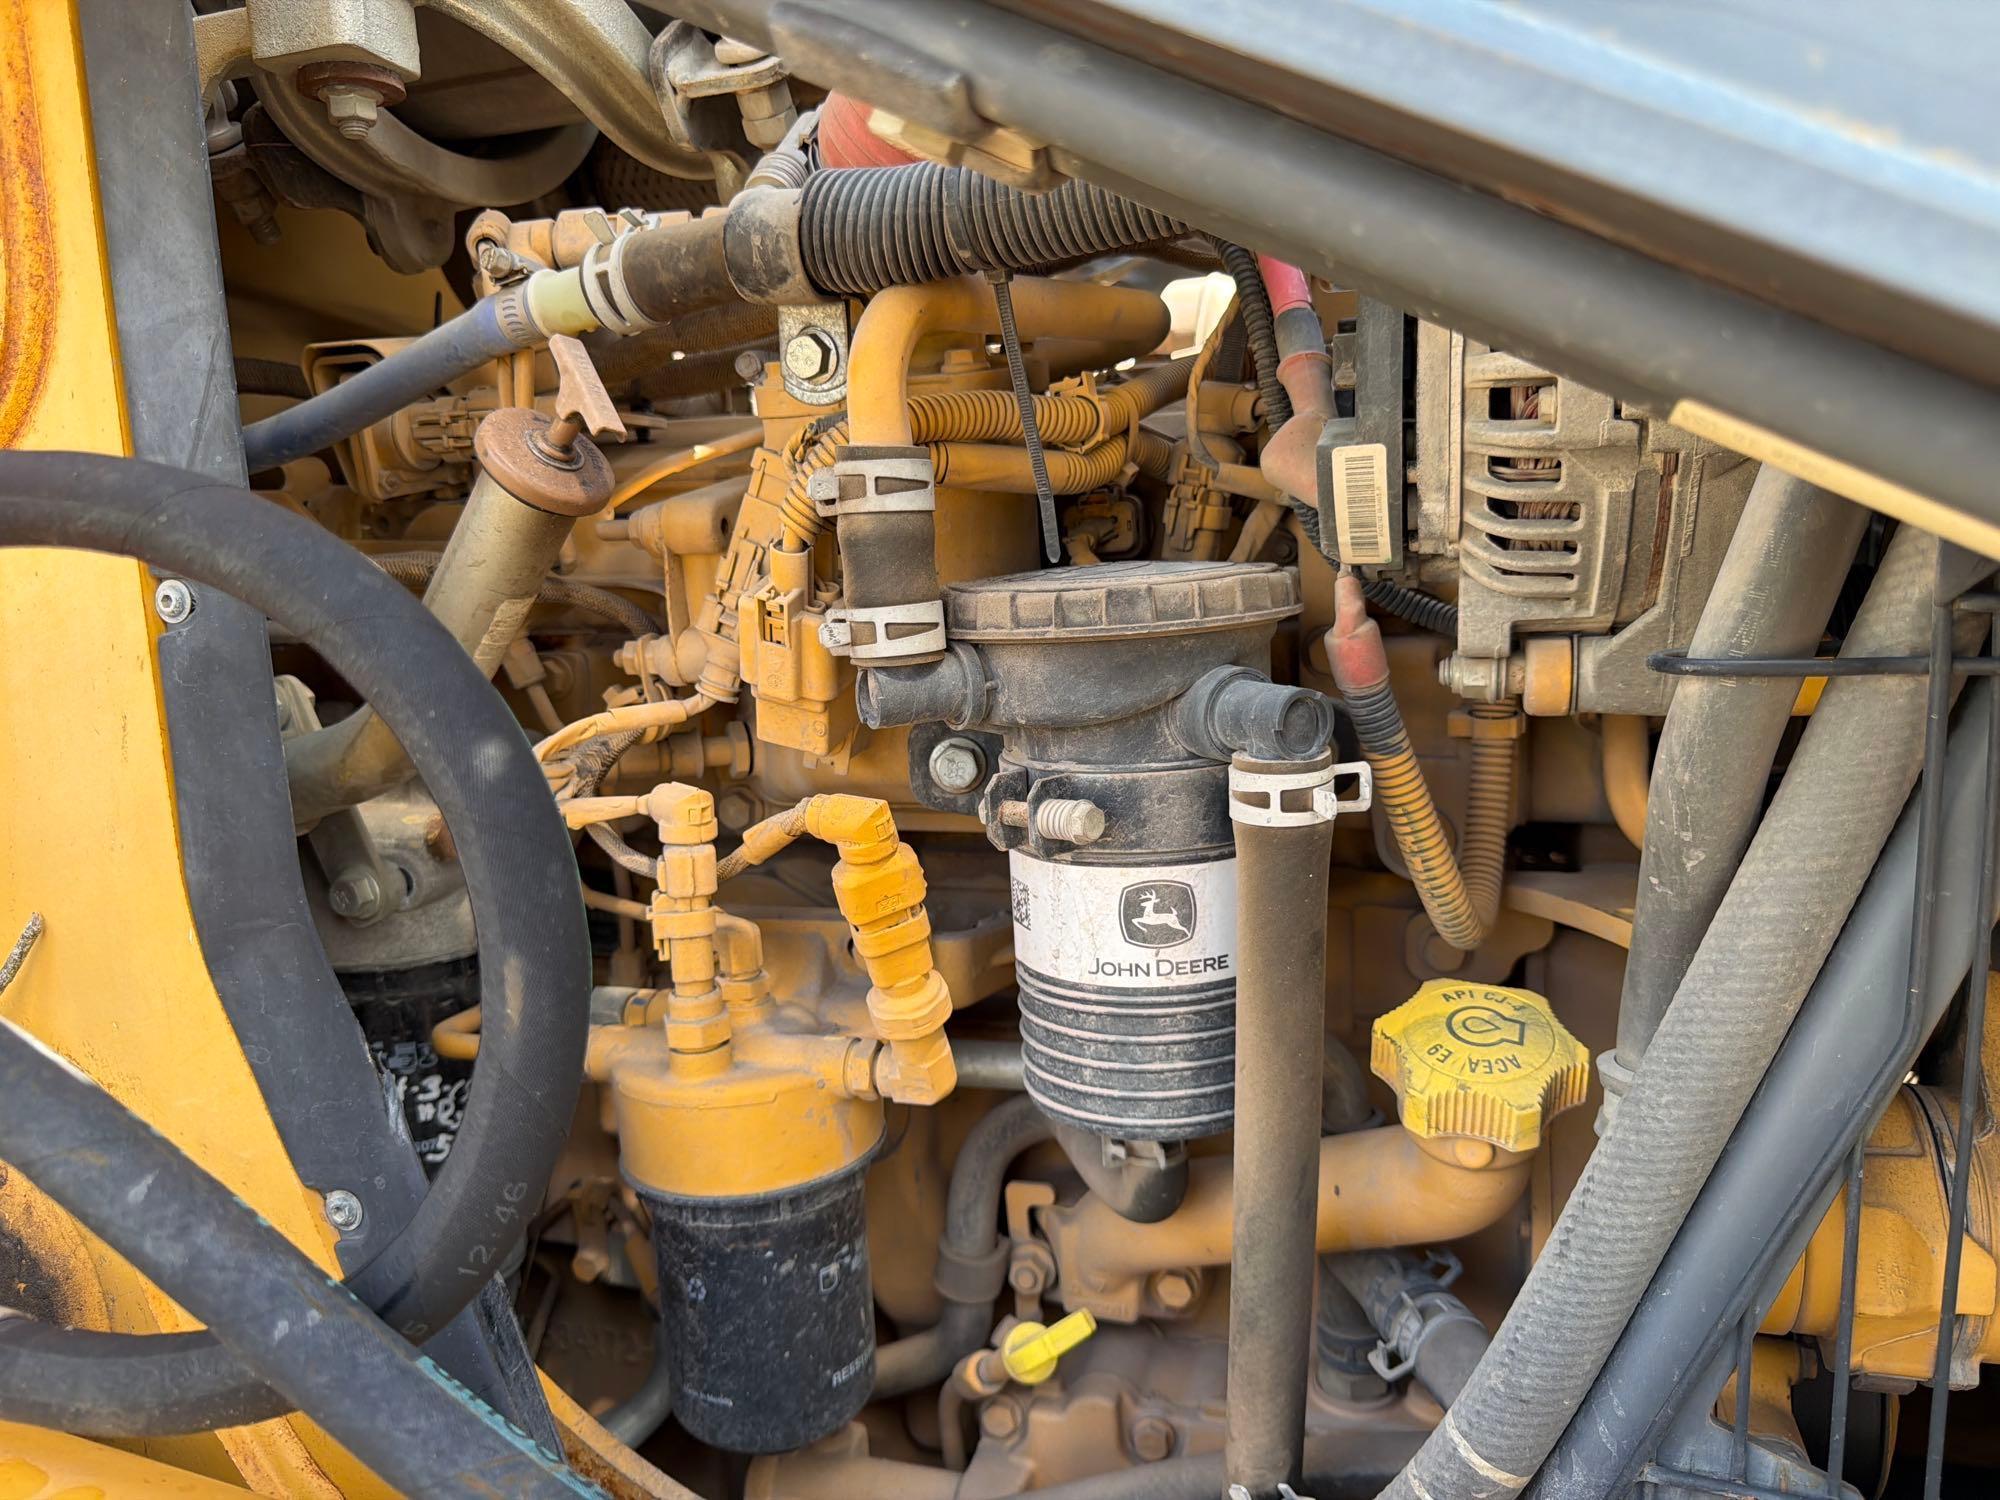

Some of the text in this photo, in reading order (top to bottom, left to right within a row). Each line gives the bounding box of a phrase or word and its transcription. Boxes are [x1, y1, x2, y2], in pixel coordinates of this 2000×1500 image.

[1088, 954, 1230, 977] JOHN DEERE
[1442, 990, 1475, 1003] API
[1468, 1054, 1522, 1074] ACEA
